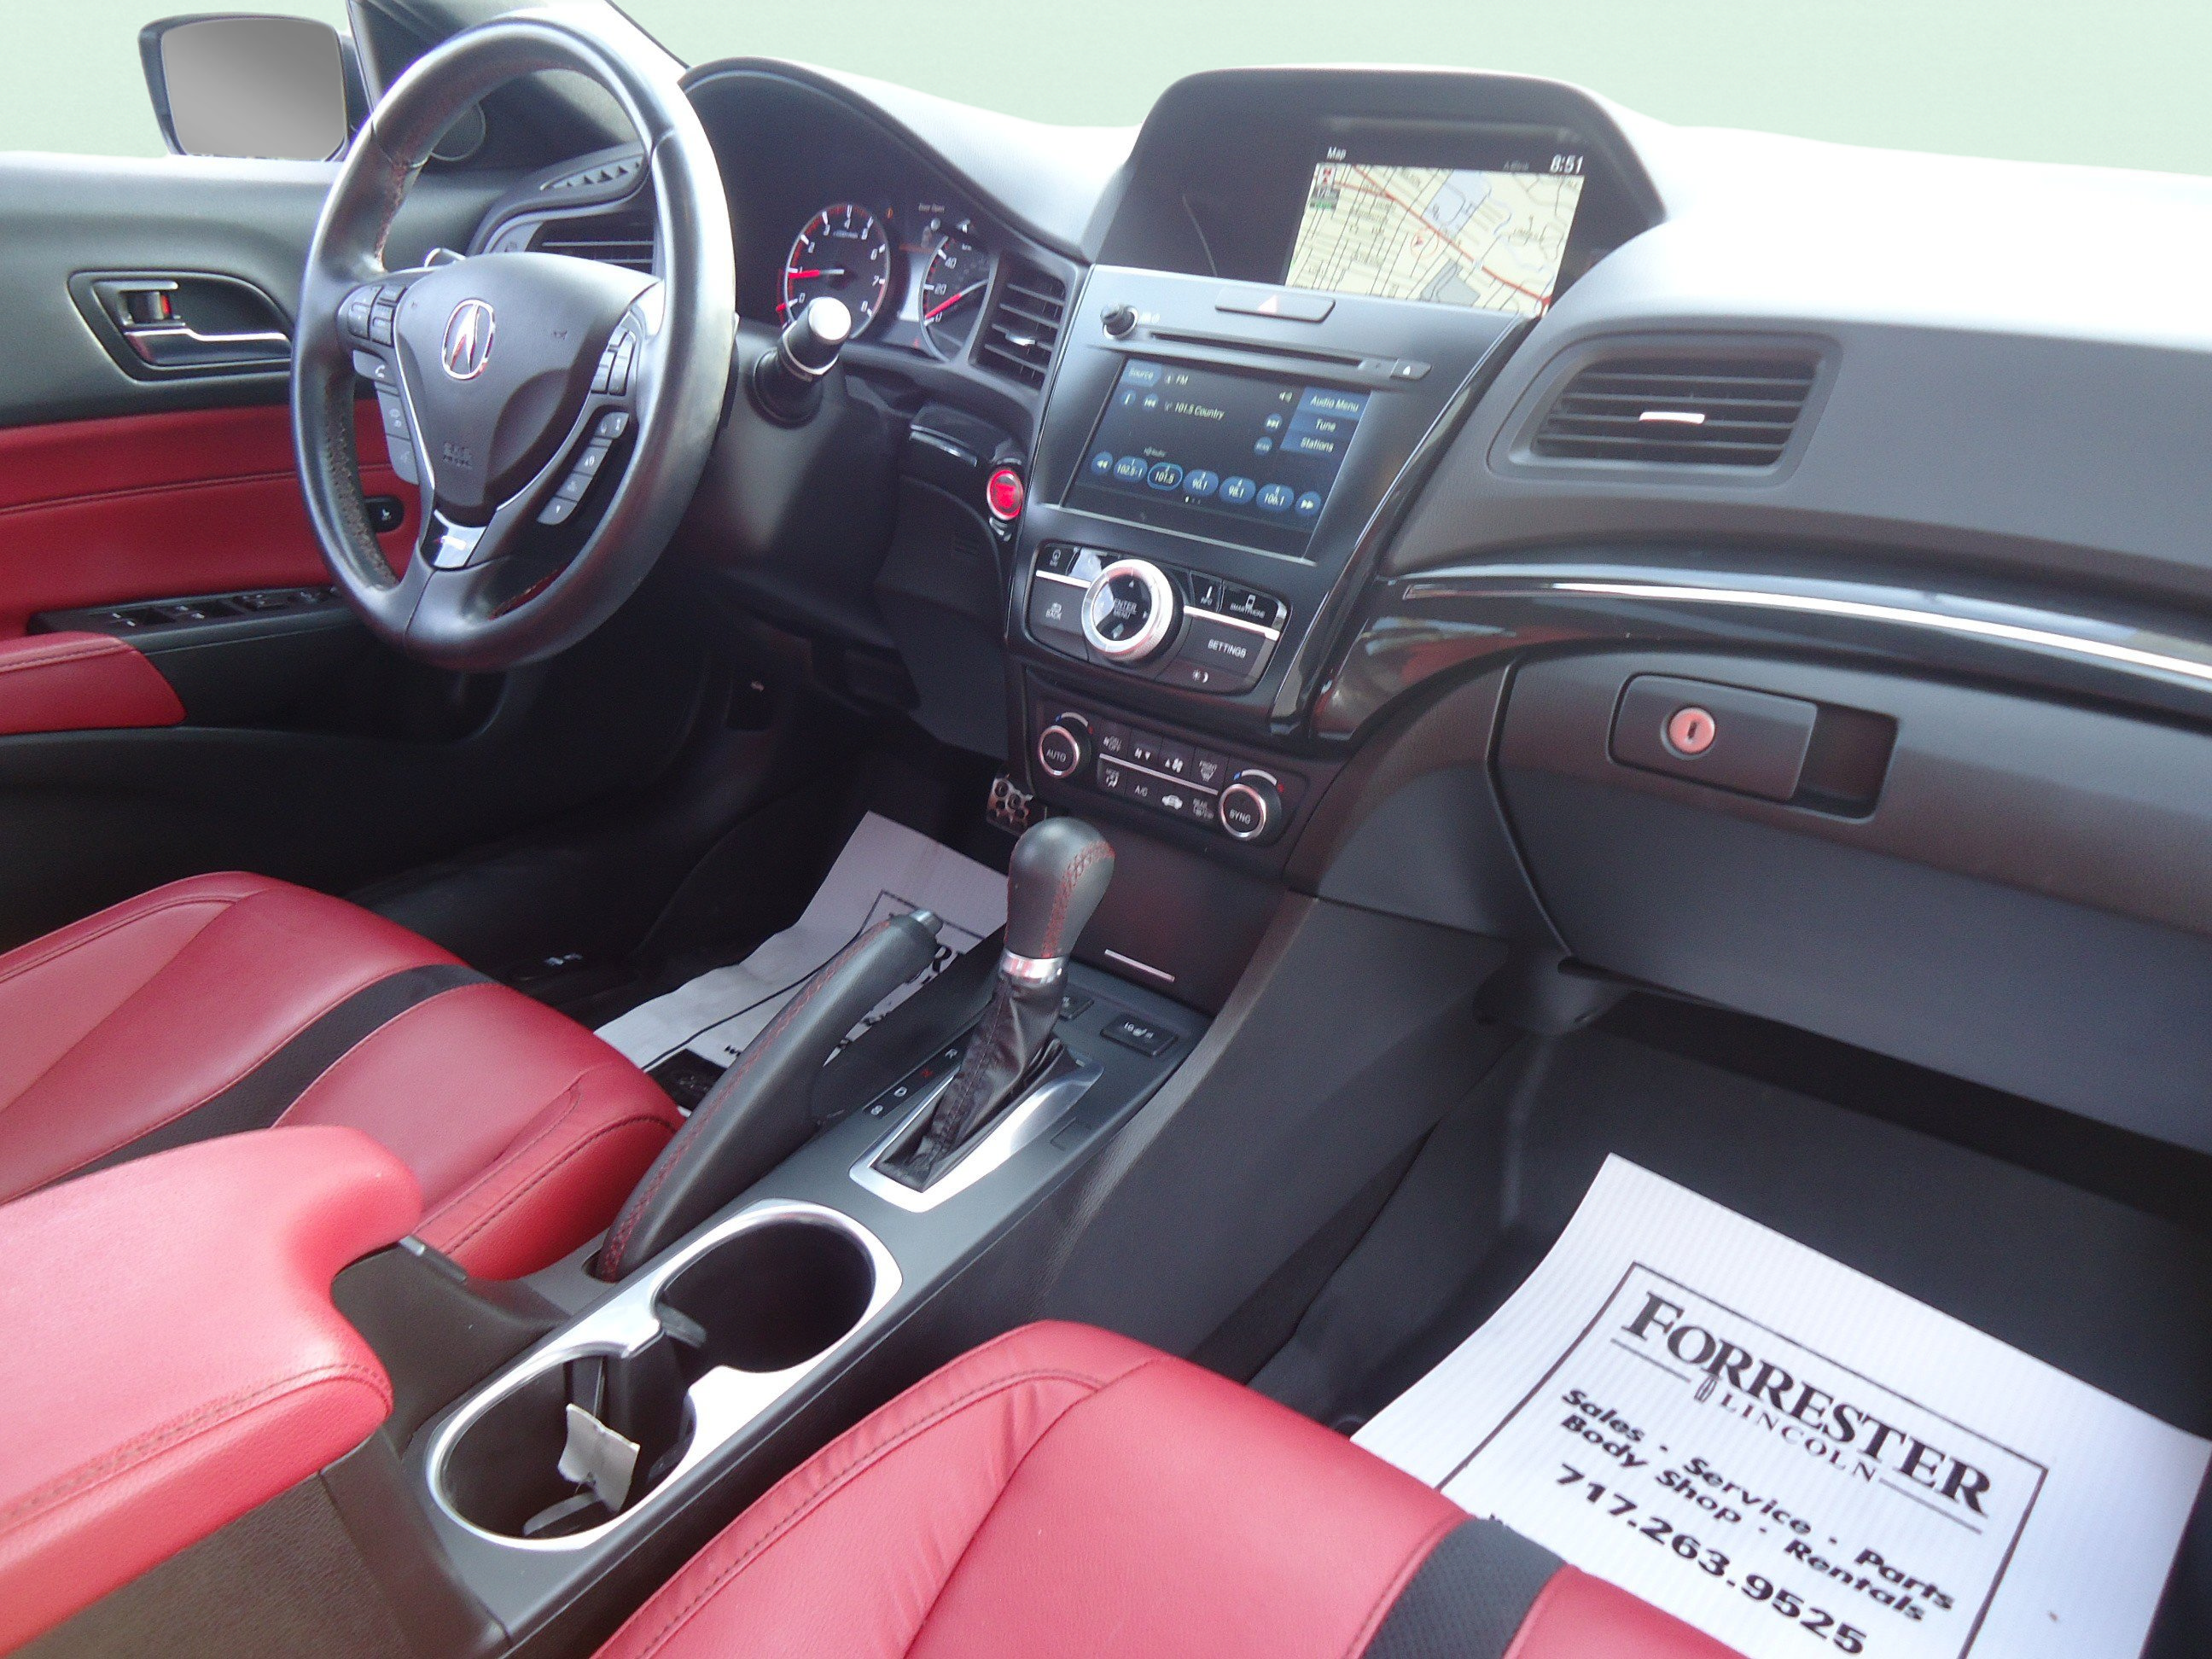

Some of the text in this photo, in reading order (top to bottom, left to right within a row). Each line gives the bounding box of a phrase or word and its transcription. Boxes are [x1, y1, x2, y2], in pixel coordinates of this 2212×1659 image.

[1327, 147, 1347, 161] Map
[1310, 395, 1360, 412] Audio Menu
[1315, 419, 1336, 433] Tune
[1300, 437, 1335, 453] Stations
[1208, 638, 1247, 659] SETTINGS
[1046, 748, 1066, 762] AUTO
[1621, 1290, 1990, 1519] FORRESTER
[1720, 1392, 1877, 1483] LINCOLN
[1562, 1388, 1955, 1611] Sales Service Parts
[1560, 1413, 1926, 1622] Body Shop Rentals
[1556, 1462, 1867, 1656] 717.263.9525
